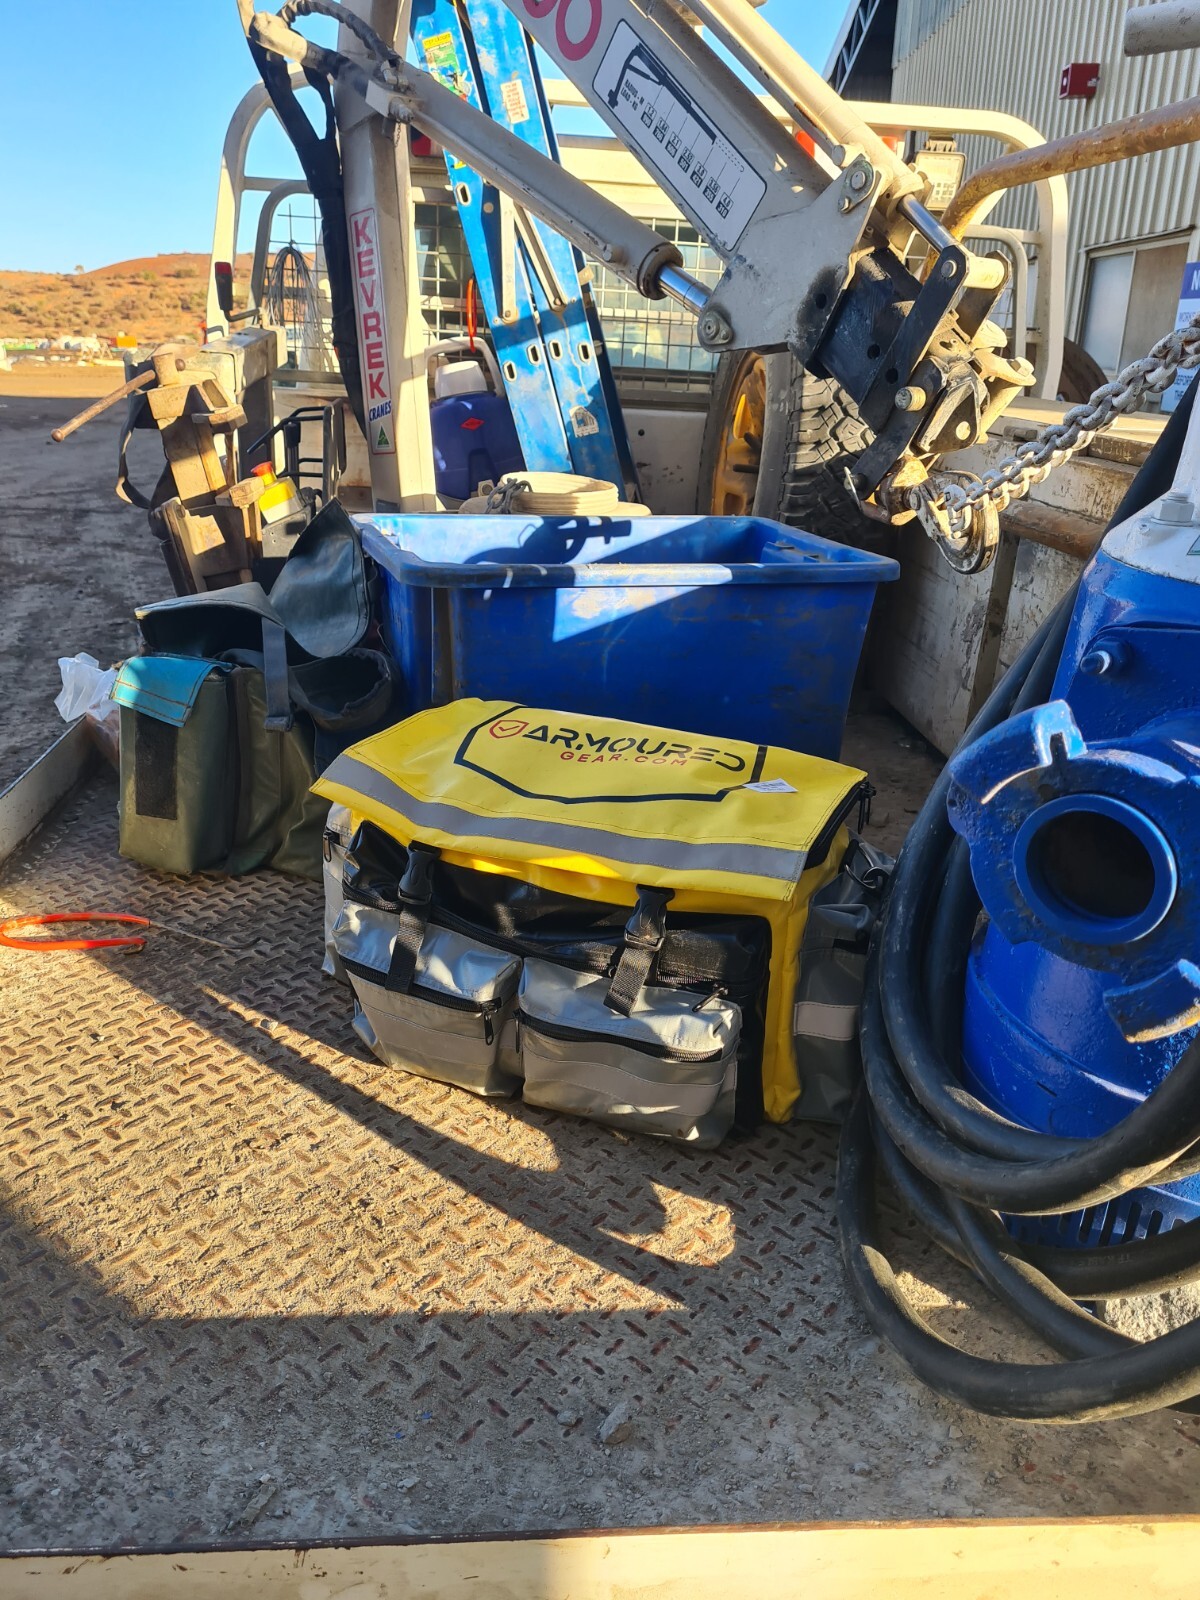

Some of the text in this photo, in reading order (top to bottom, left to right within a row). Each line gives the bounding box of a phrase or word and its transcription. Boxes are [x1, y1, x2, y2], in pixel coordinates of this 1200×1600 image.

[354, 216, 387, 399] KEVREK
[369, 401, 391, 421] CRANES
[522, 725, 746, 772] ARMOURED
[560, 751, 688, 766] GEAR.COM
